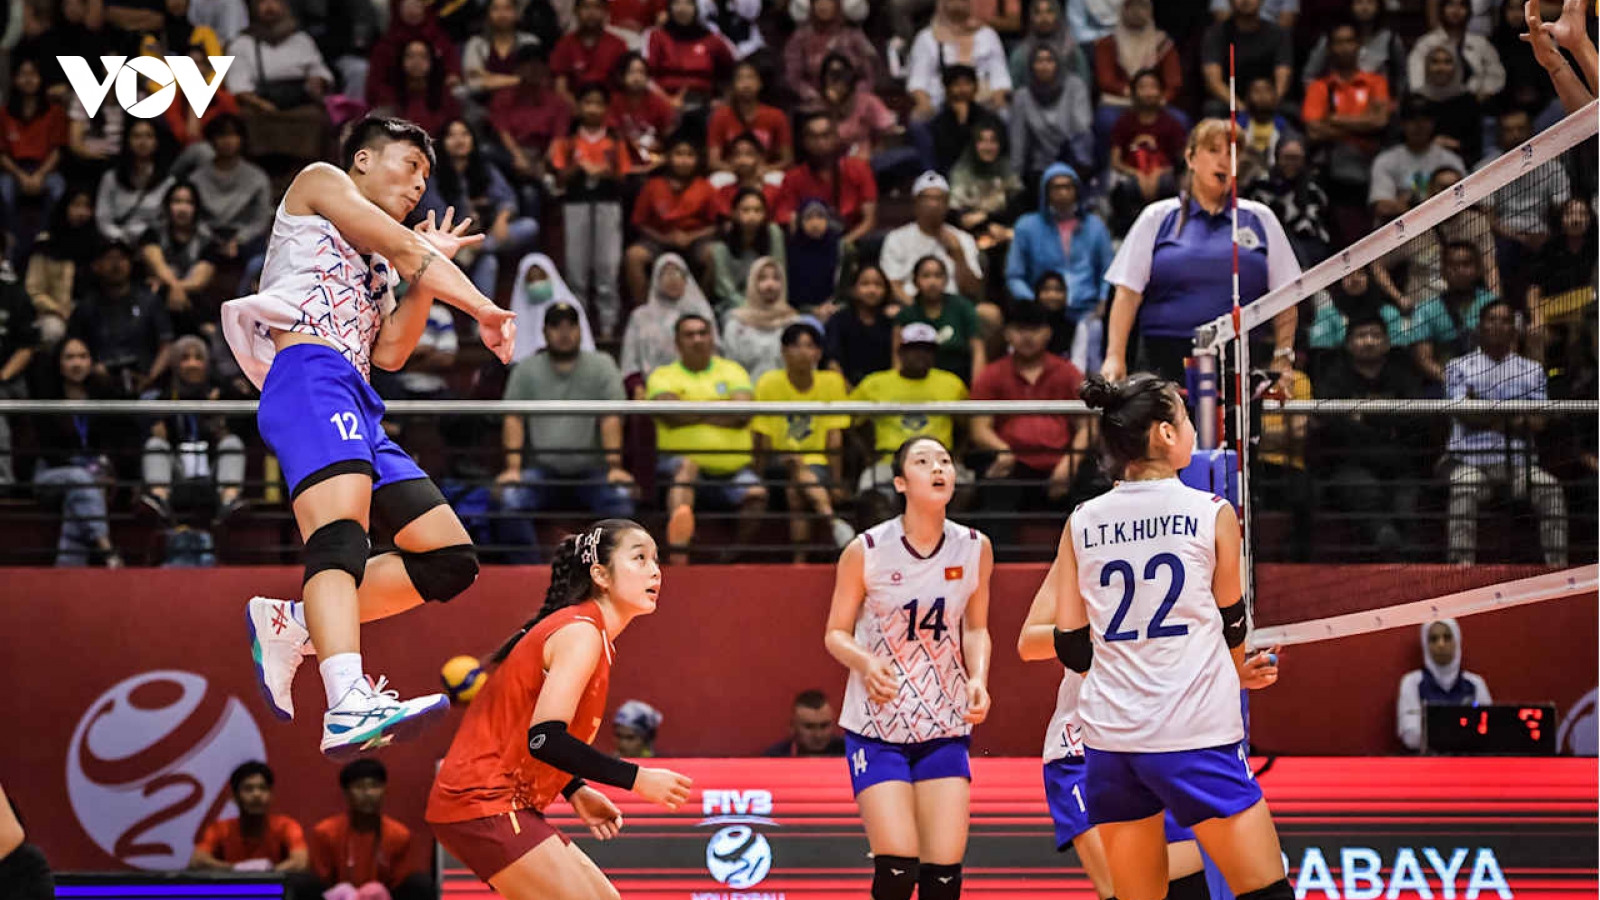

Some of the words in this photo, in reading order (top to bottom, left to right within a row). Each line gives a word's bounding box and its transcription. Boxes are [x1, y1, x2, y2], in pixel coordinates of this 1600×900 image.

[330, 412, 362, 440] 12
[1083, 514, 1199, 549] L.T.K.HUYEN
[1100, 552, 1189, 642] 22
[902, 597, 948, 641] 14
[851, 747, 868, 777] 14
[701, 789, 773, 815] FIVB
[1281, 847, 1514, 900] ABAYA
